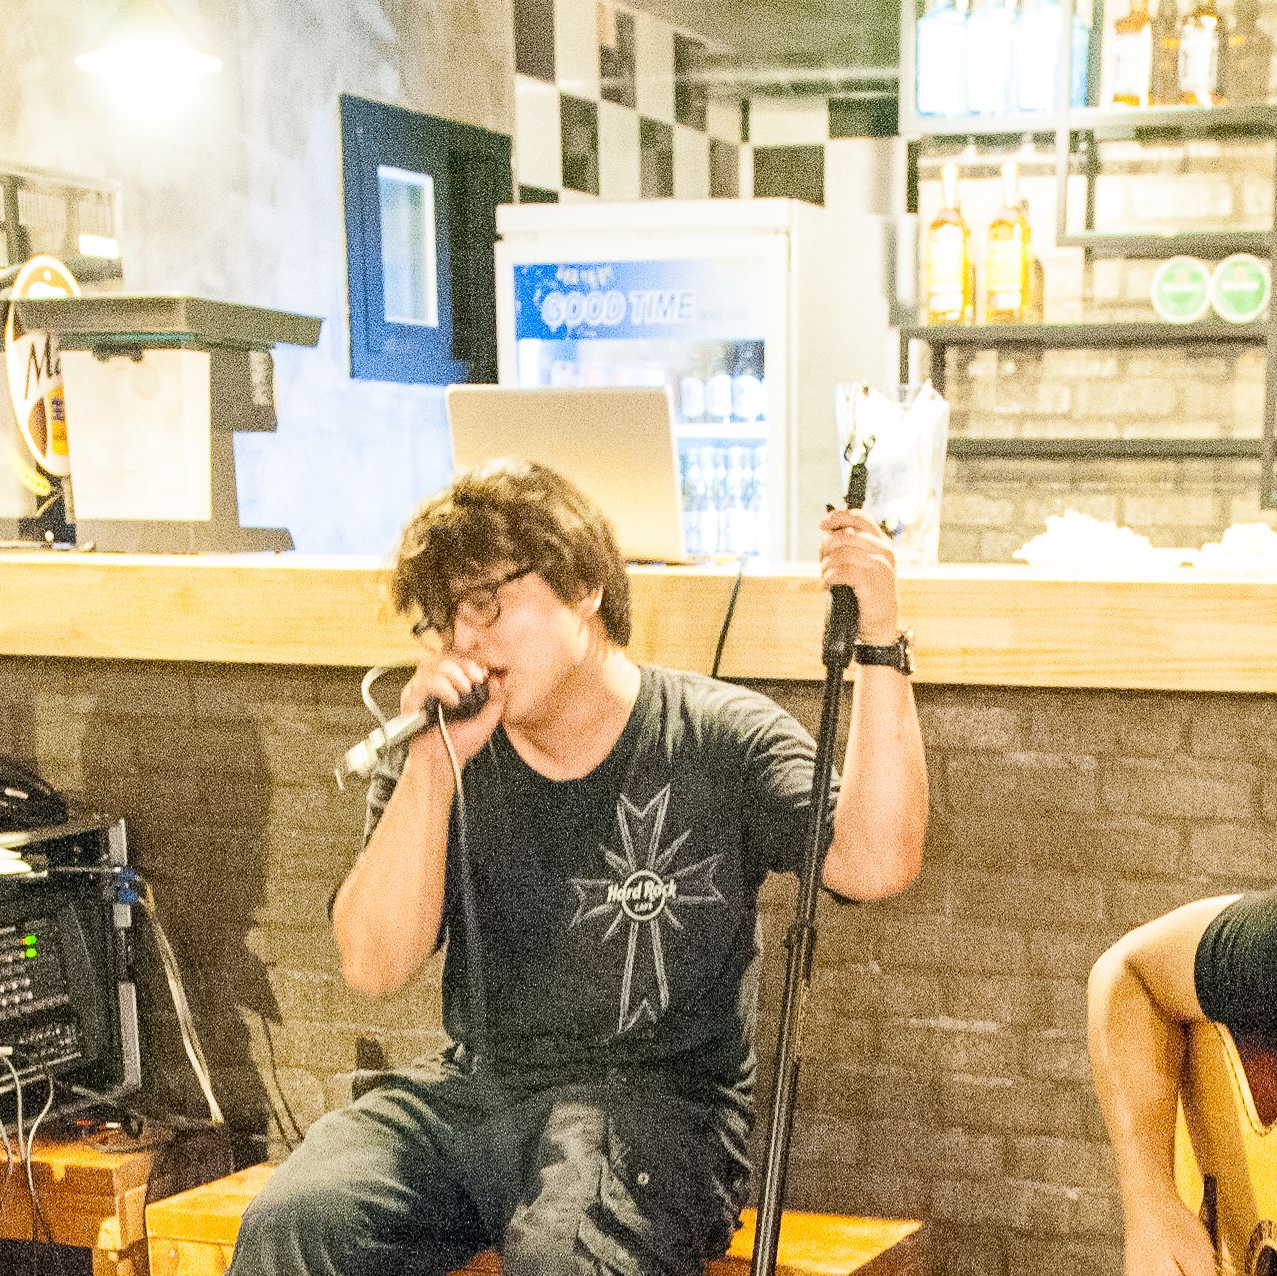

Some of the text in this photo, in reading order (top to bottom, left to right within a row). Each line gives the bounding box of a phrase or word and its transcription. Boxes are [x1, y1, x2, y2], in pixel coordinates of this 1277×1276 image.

[544, 289, 696, 324] GOOD TIME
[607, 879, 677, 902] Hard Rock
